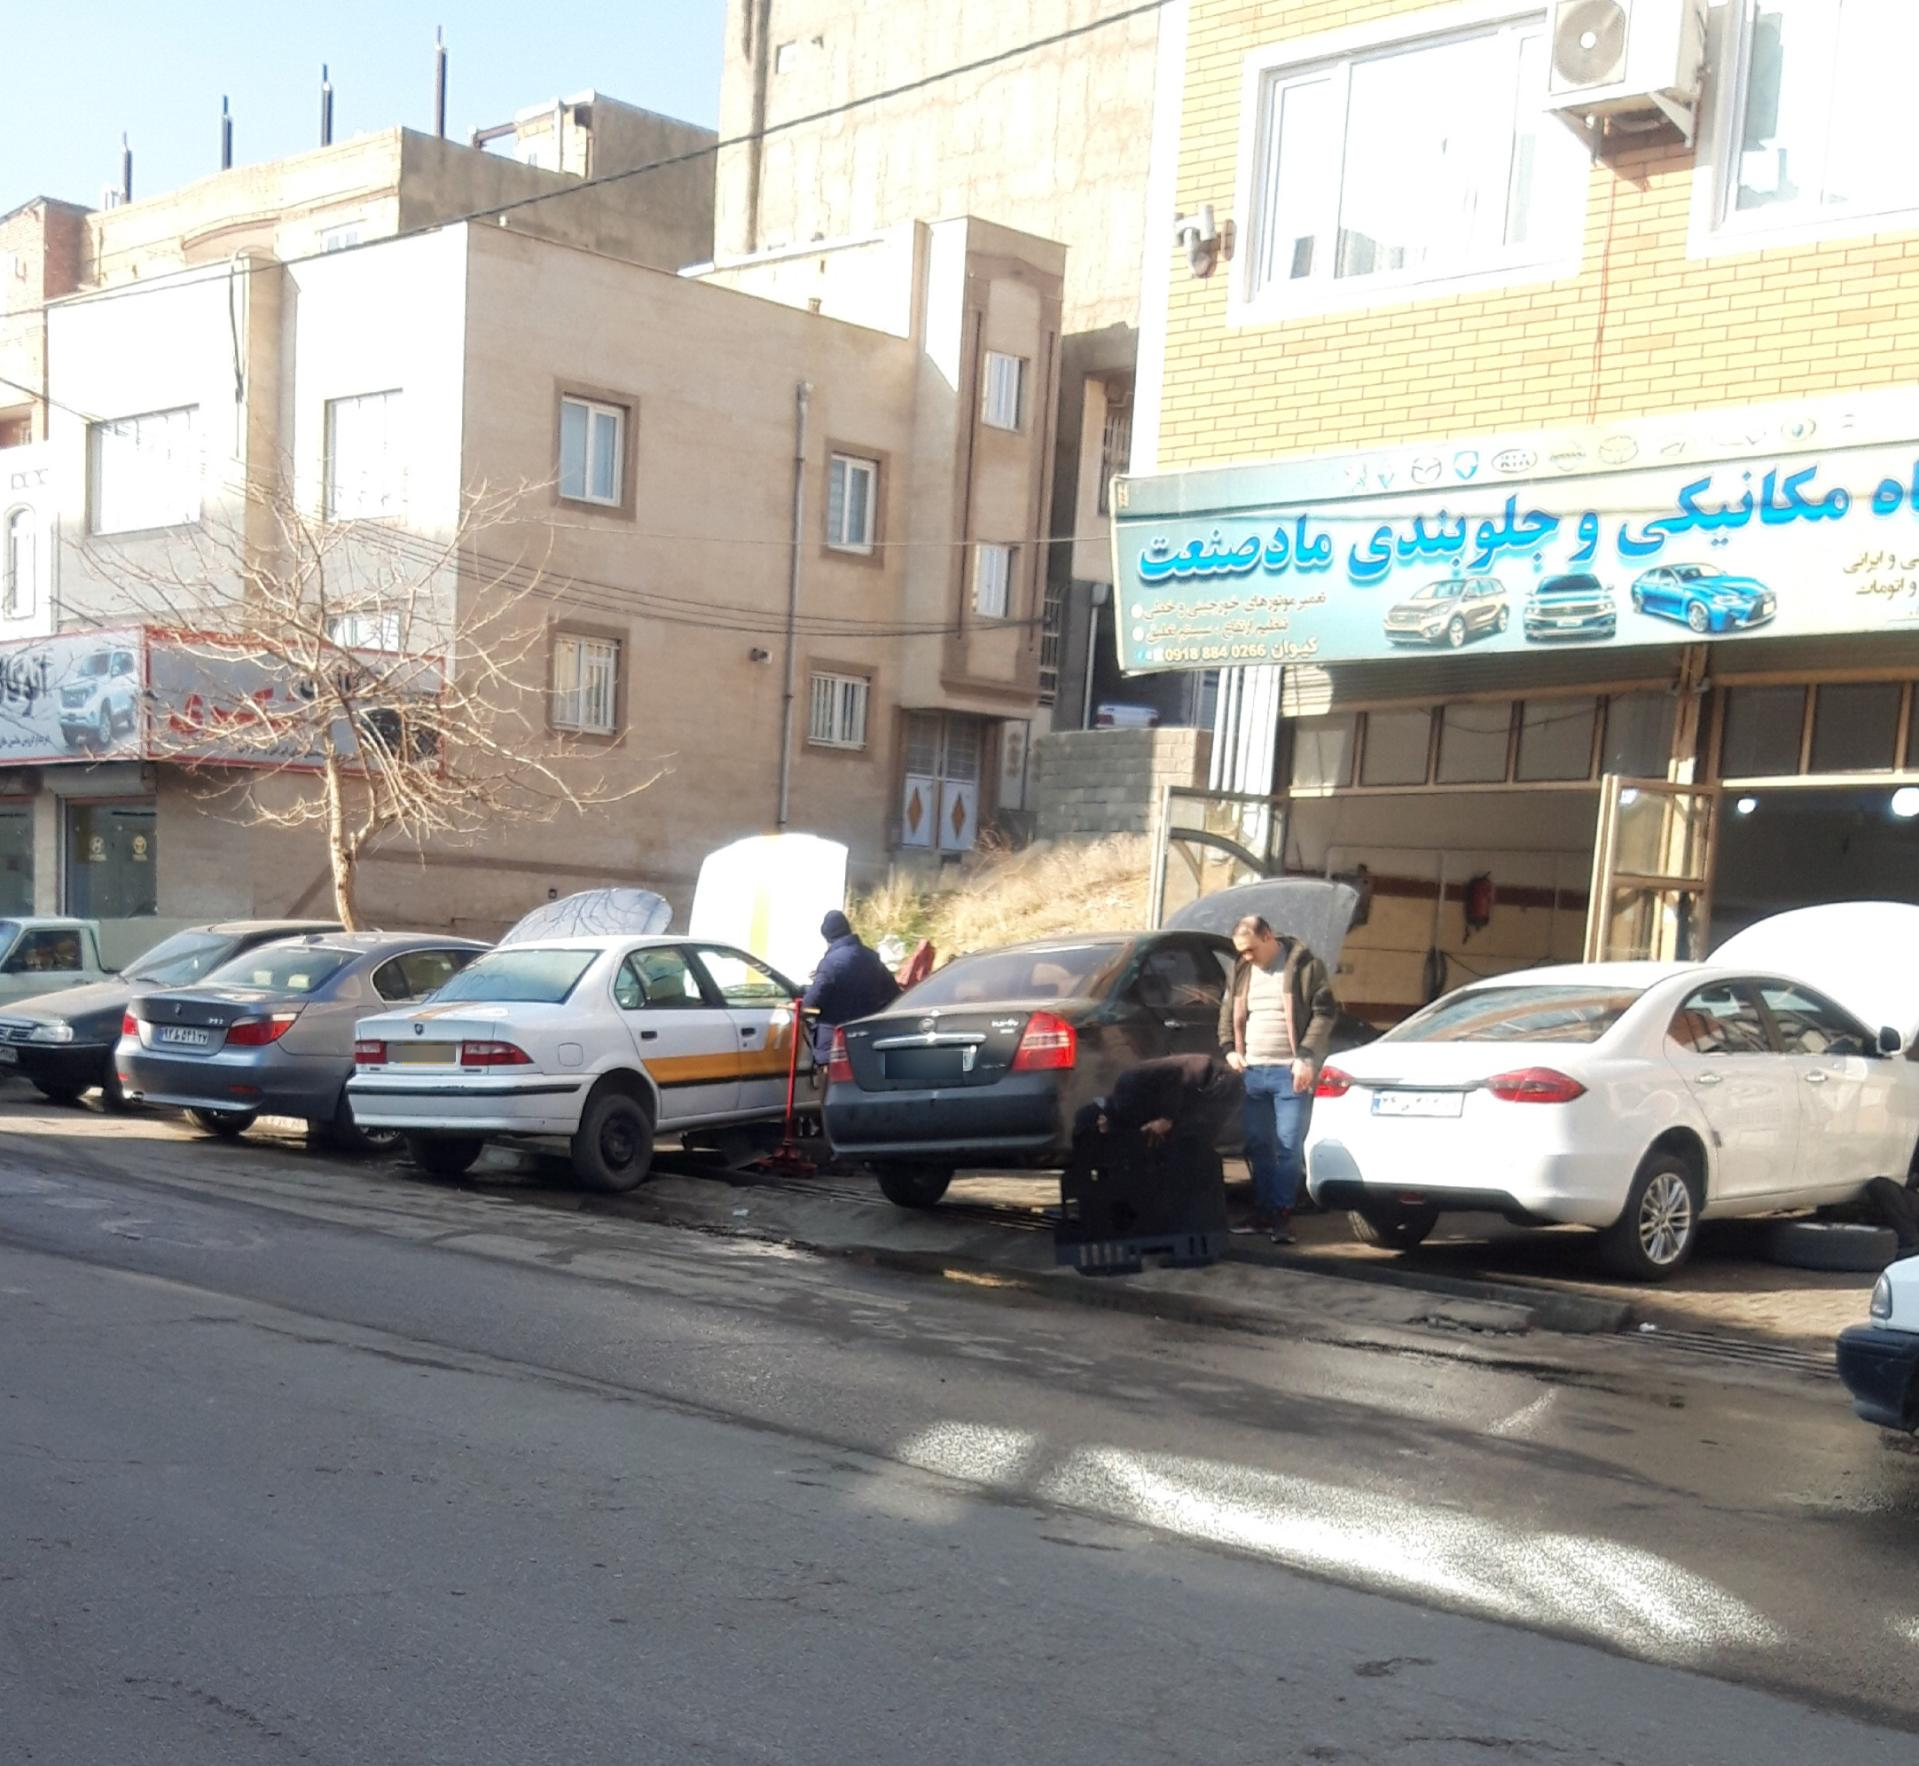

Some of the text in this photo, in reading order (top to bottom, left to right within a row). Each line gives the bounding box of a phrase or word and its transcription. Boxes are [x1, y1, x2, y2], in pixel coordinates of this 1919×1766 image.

[1348, 494, 1562, 580] جلوبندی
[1568, 510, 1600, 563] و
[1616, 463, 1849, 558] مکانیکی
[1842, 549, 1884, 574] ایرانی
[1164, 648, 1200, 662] 0918
[1202, 646, 1228, 660] 884
[1231, 644, 1267, 659] 0266
